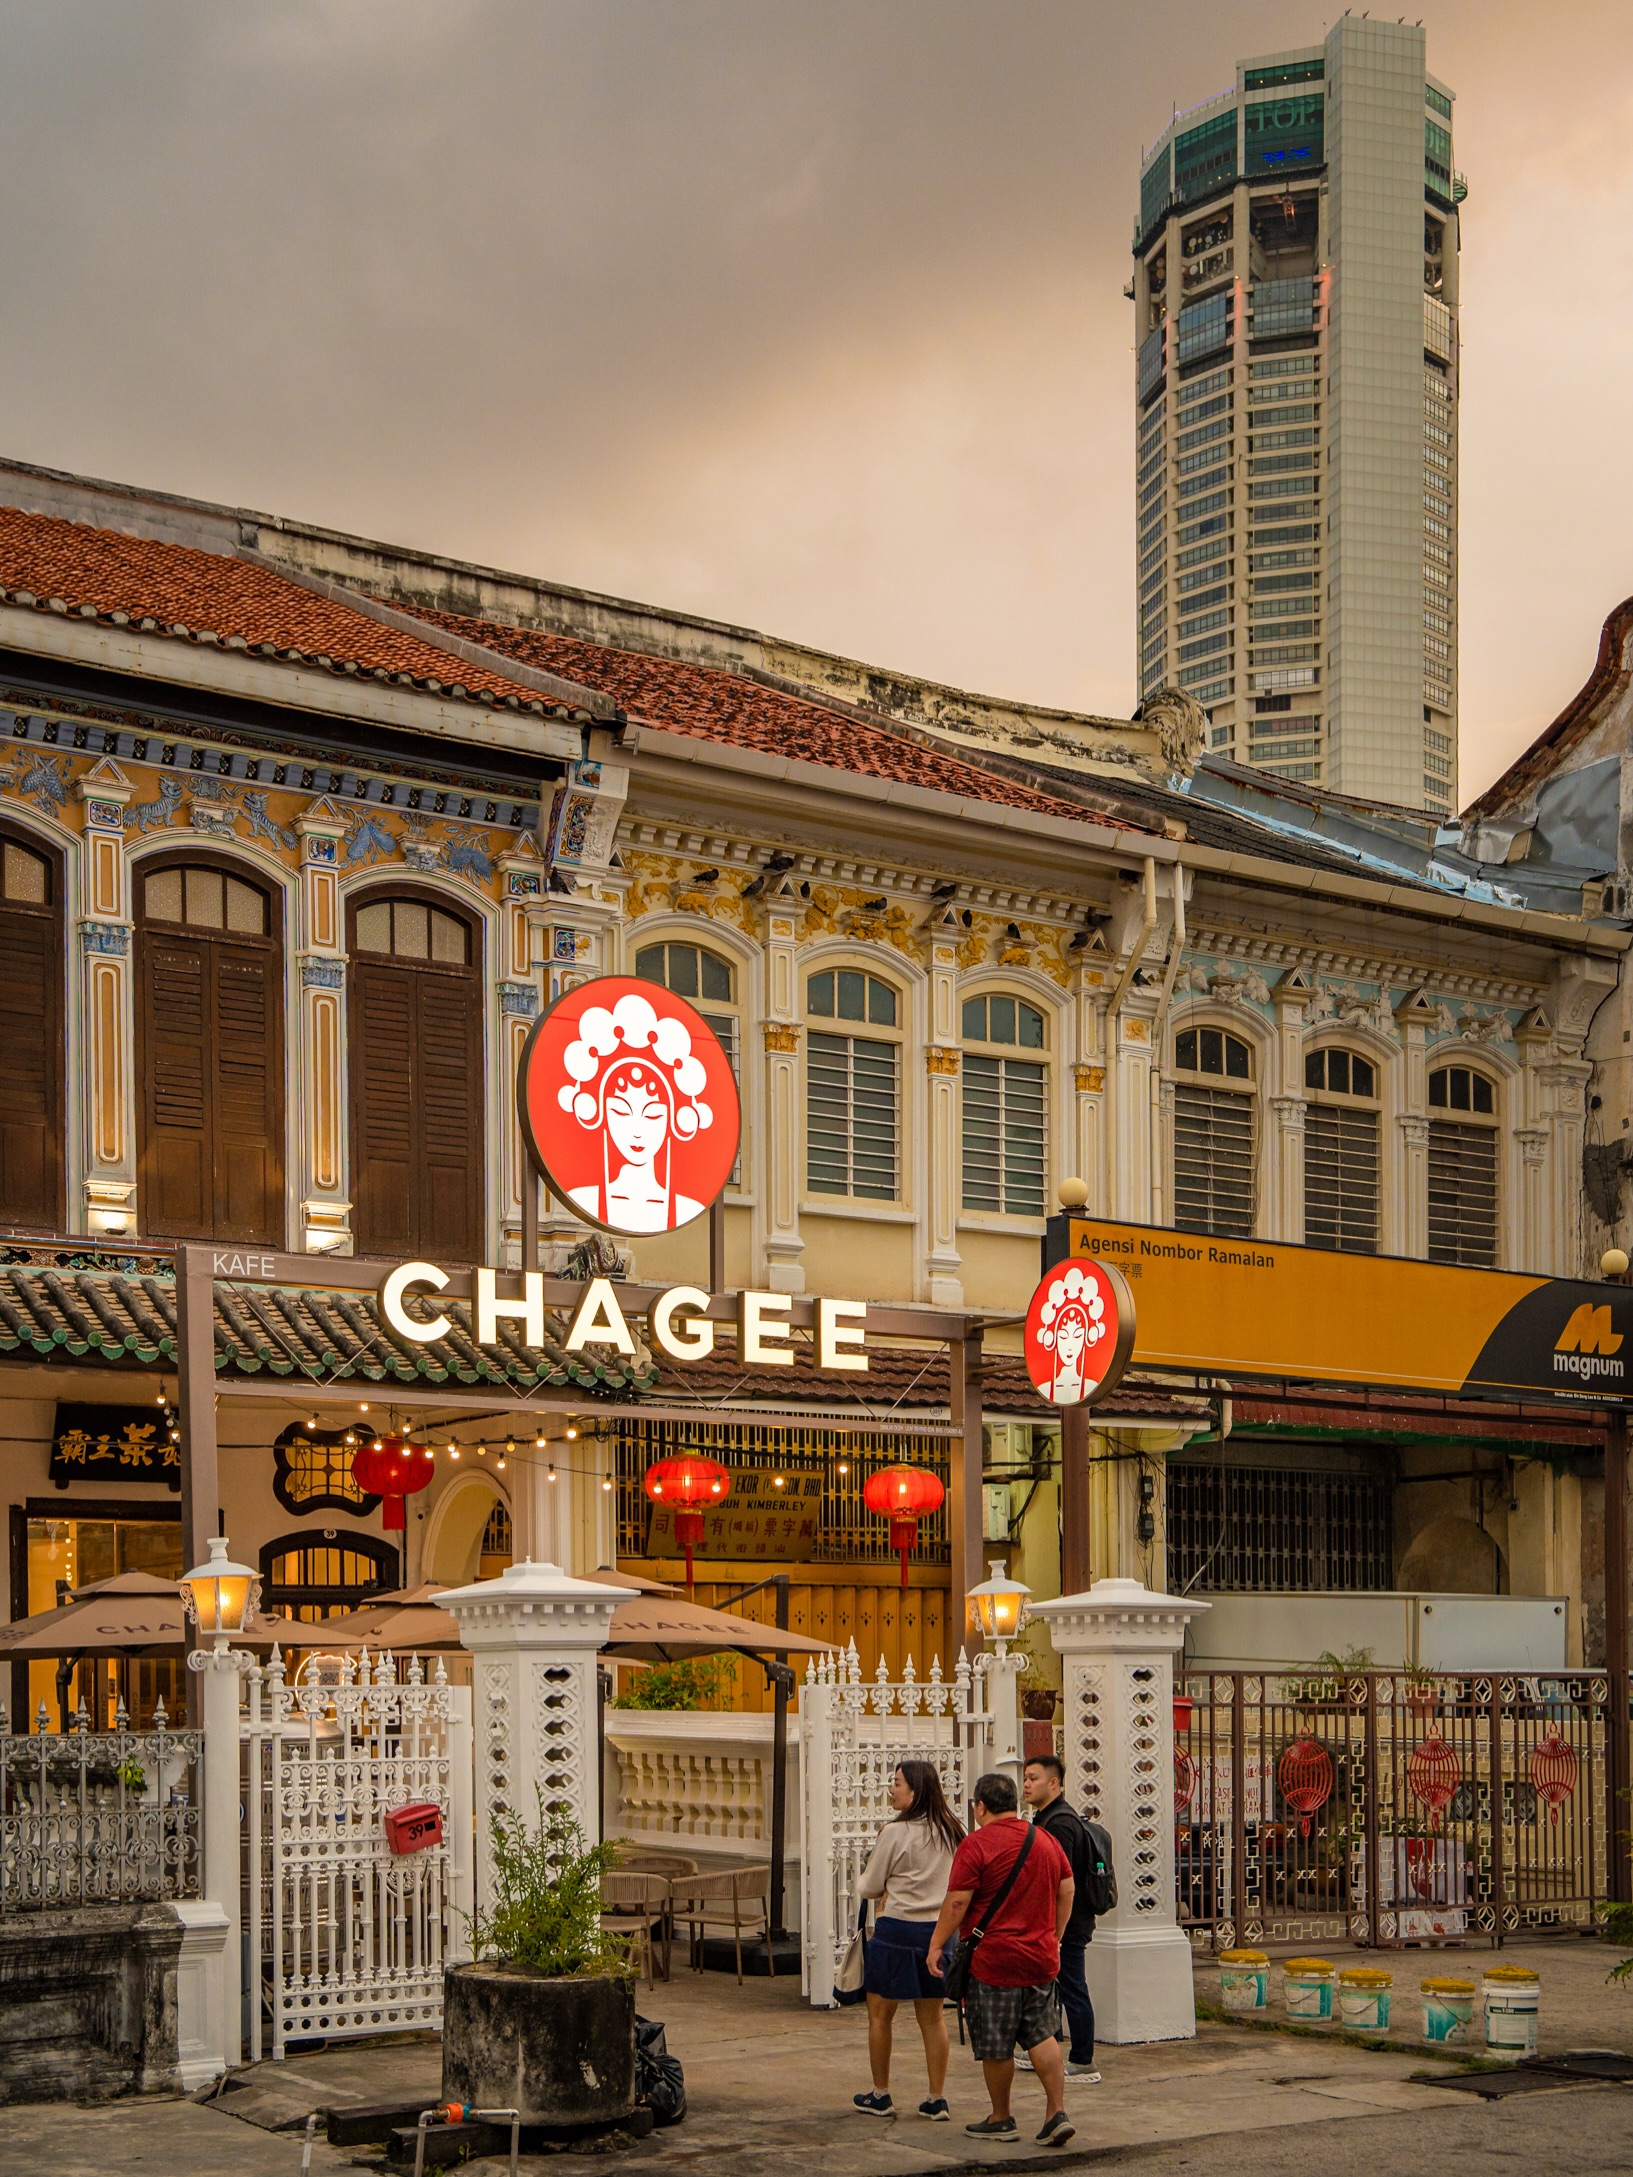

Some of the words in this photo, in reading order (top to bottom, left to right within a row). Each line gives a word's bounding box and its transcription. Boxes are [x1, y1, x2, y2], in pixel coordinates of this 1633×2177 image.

[1080, 1234, 1134, 1254] Agensi
[1140, 1240, 1203, 1260] Nombor
[1208, 1247, 1275, 1268] Ramalan
[213, 1253, 276, 1278] KAFE
[377, 1260, 869, 1372] CHAGEE
[1553, 1353, 1625, 1381] magnum
[735, 1475, 759, 1494] EKOR
[803, 1478, 821, 1497] BHD.
[746, 1500, 807, 1511] KIMBERLEY
[326, 1530, 335, 1538] 39
[96, 1623, 263, 1635] CHAE
[408, 1823, 424, 1840] 39
